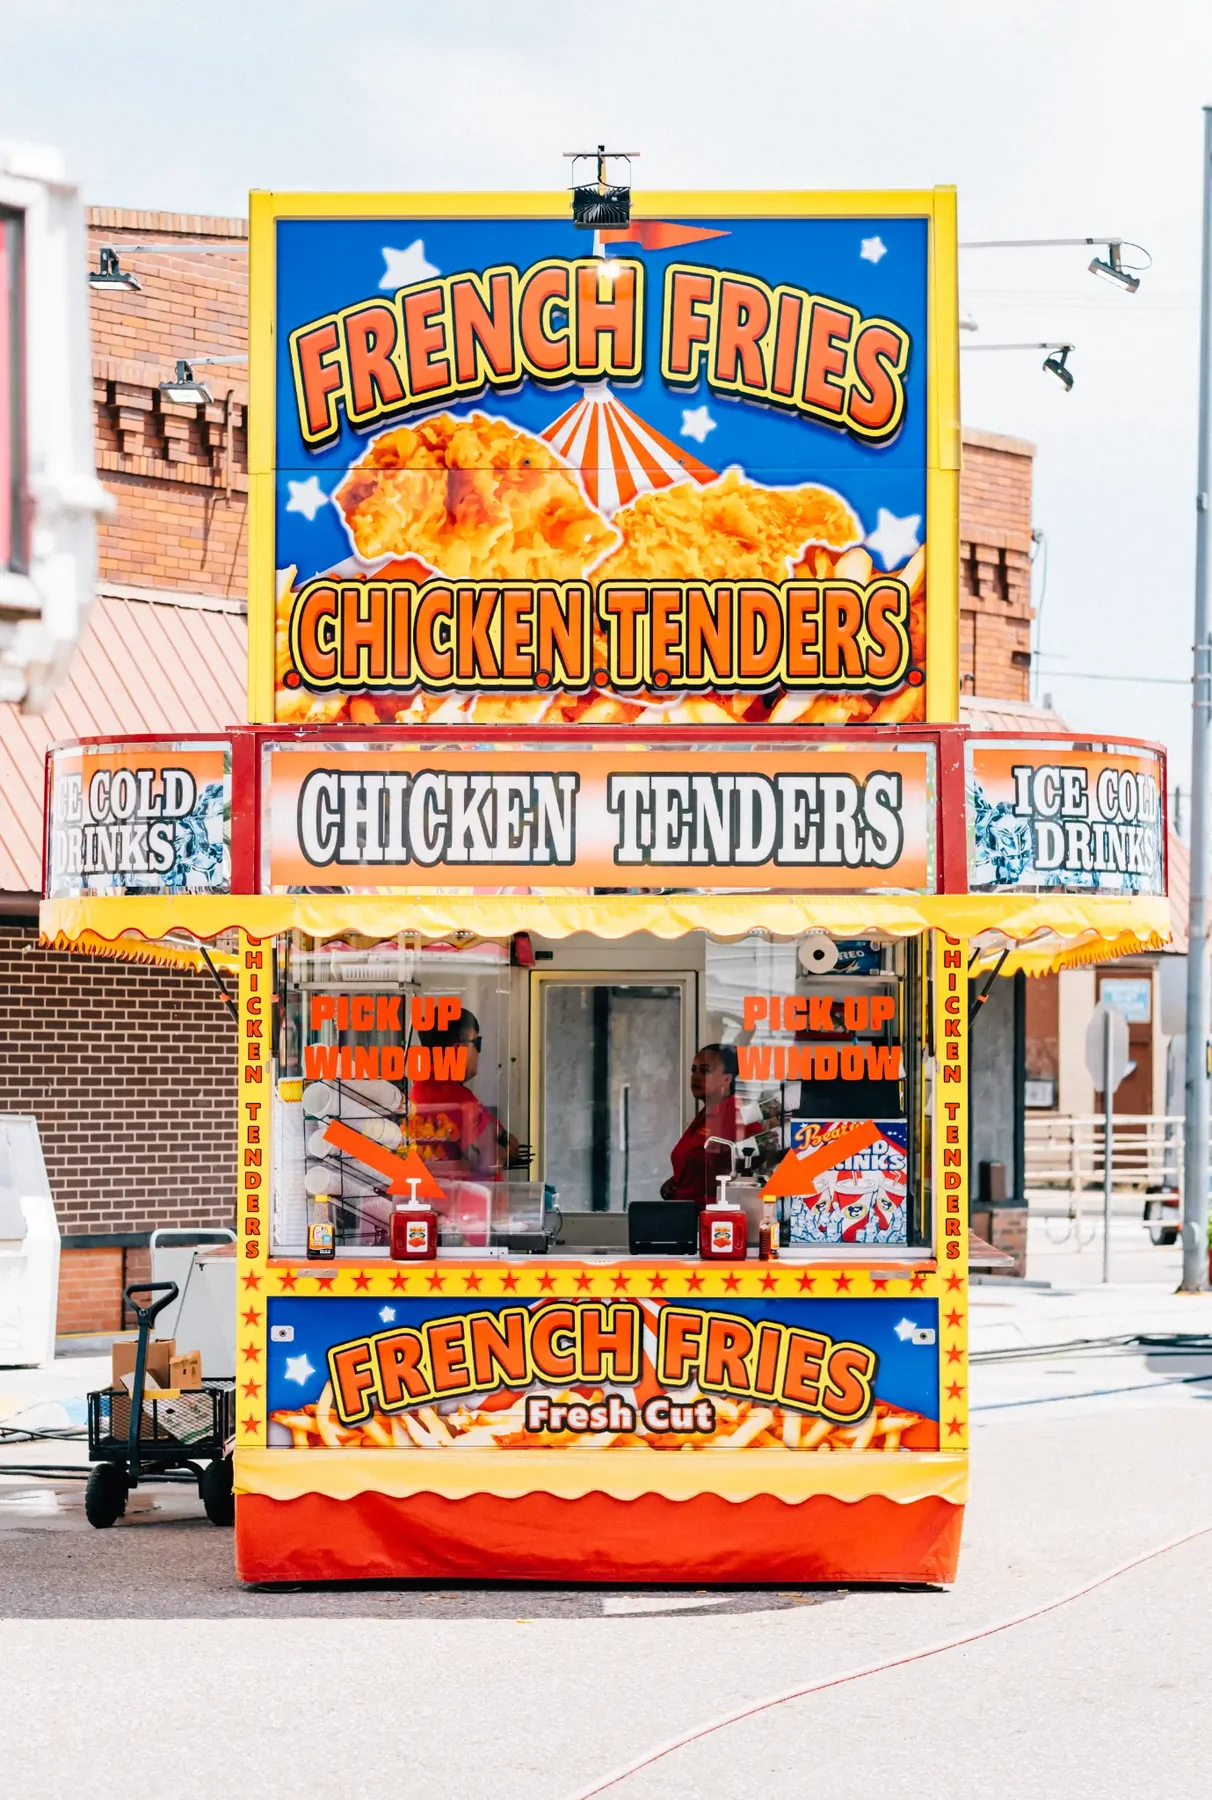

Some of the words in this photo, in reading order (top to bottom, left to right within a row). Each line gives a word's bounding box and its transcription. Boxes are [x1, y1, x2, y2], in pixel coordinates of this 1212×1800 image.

[290, 257, 645, 449] FRENCH
[661, 261, 911, 441] FRIES
[289, 578, 594, 687] CHICKEN
[599, 578, 909, 687] TENDERS
[56, 774, 83, 823] CE
[89, 768, 197, 822] COLD
[300, 768, 580, 867] CHICKEN
[607, 771, 904, 868] TENDERS
[1012, 765, 1089, 818] ICE
[1097, 767, 1157, 823] COLD
[55, 821, 176, 875] DRINKS
[1033, 820, 1154, 876] DRINKS
[838, 950, 865, 960] REO
[311, 996, 402, 1031] PICK
[411, 996, 462, 1031] UP
[743, 996, 834, 1031] PICK
[844, 996, 895, 1031] UP
[304, 1046, 468, 1081] WINDOW
[737, 1046, 901, 1080] WINDOW
[244, 1102, 262, 1259] TENDERS
[834, 1154, 906, 1171] INKS
[943, 1102, 961, 1260] TENDERS
[327, 1301, 642, 1426] FRENCH
[656, 1304, 880, 1423] FRIES
[524, 1397, 634, 1432] Fresh
[651, 1397, 715, 1433] Cut
